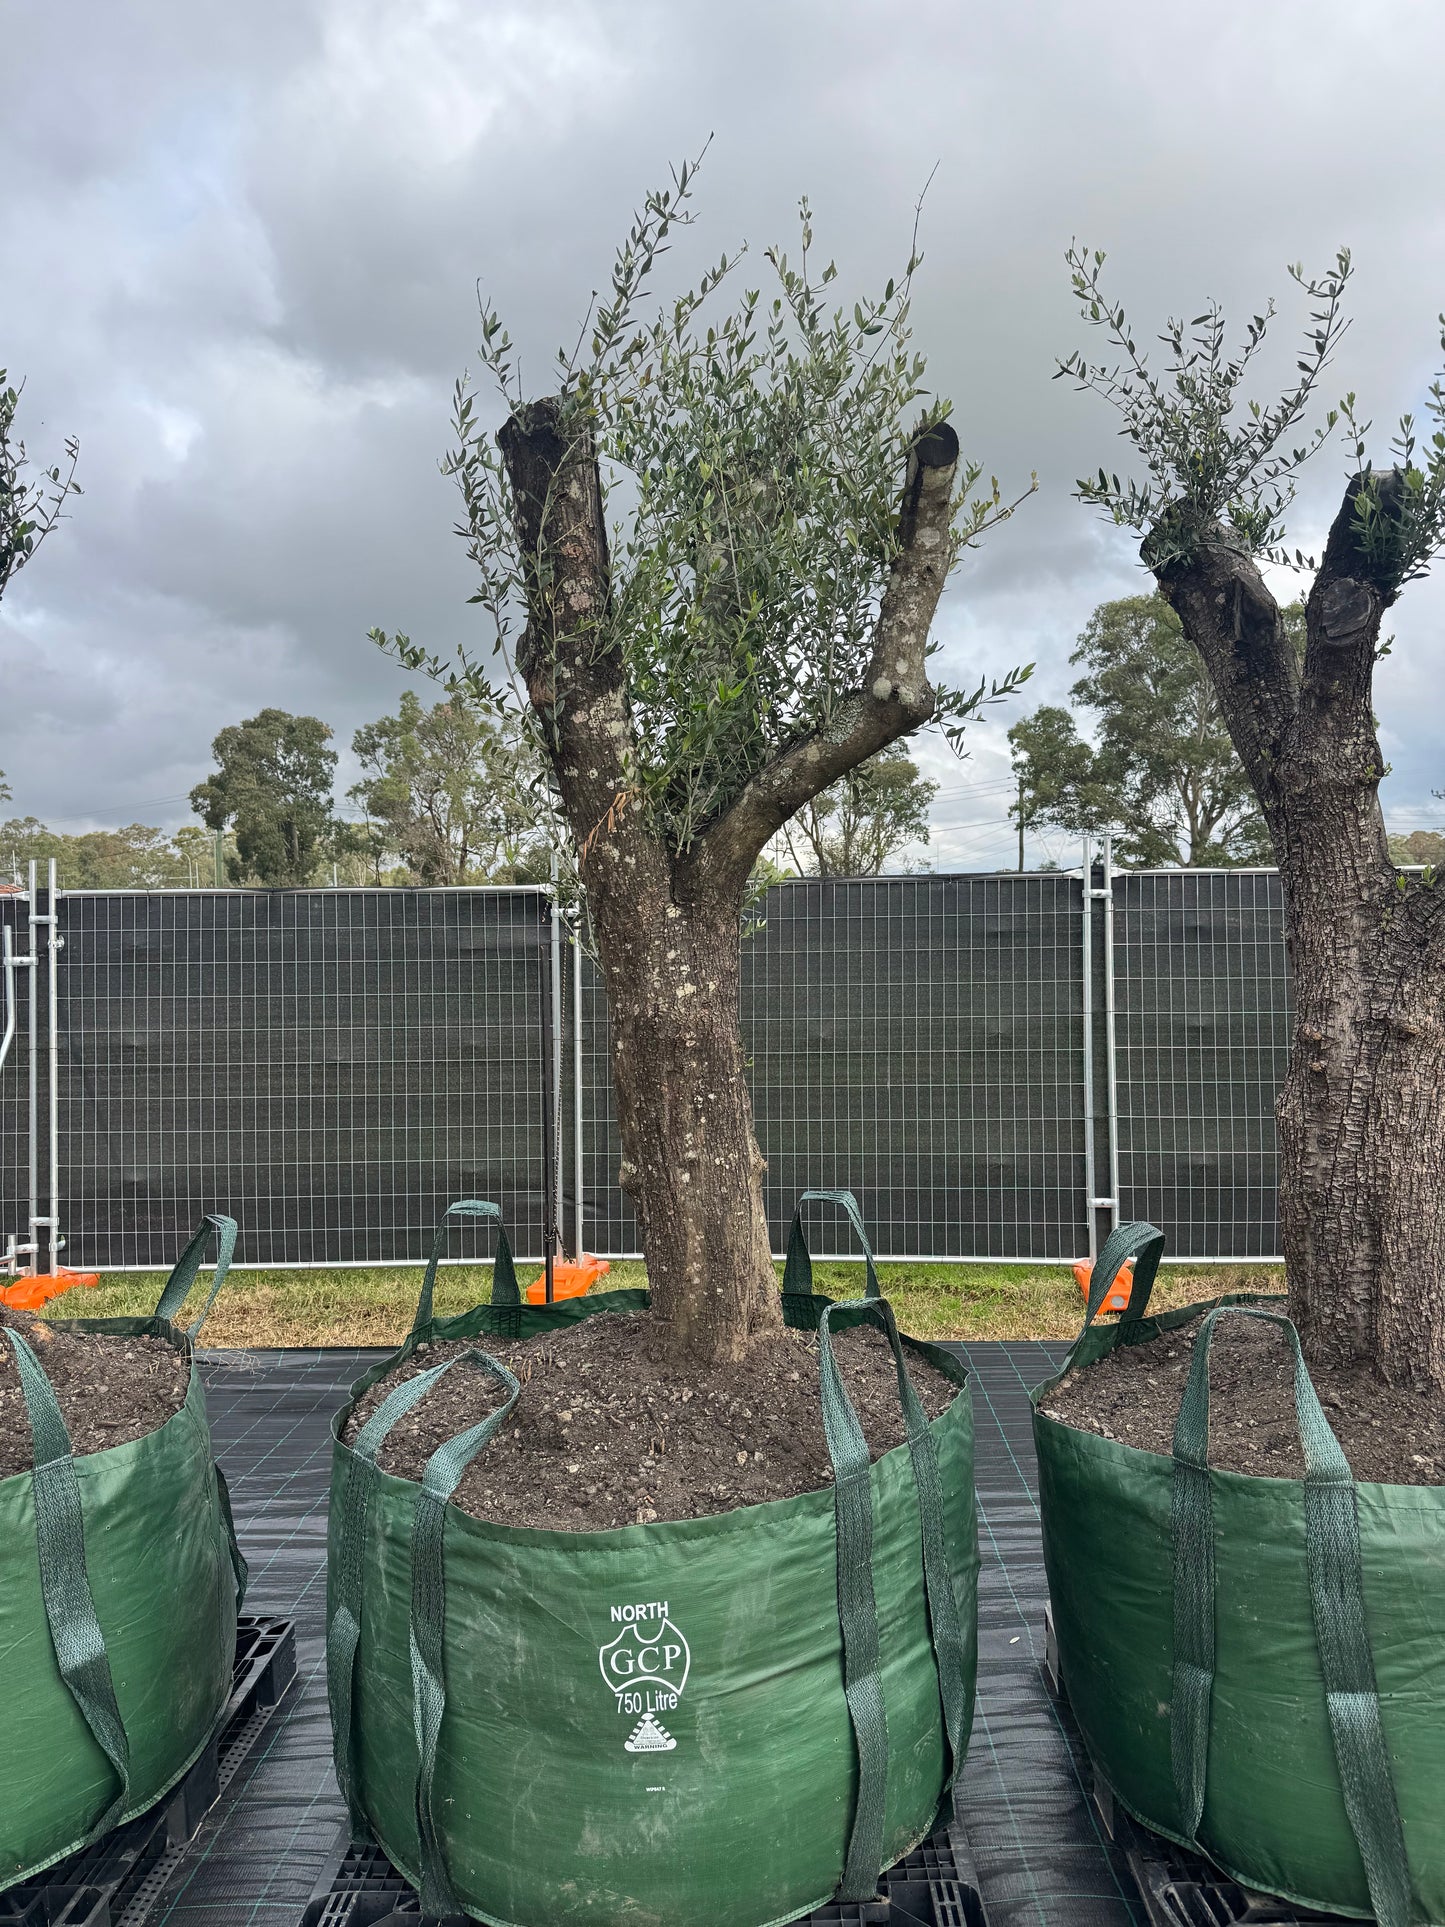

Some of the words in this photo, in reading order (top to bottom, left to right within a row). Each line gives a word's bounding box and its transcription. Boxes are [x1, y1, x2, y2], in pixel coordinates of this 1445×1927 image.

[610, 1601, 668, 1622] NORTH
[610, 1645, 681, 1675] GCP
[615, 1692, 642, 1714] 750
[646, 1690, 678, 1712] Litre
